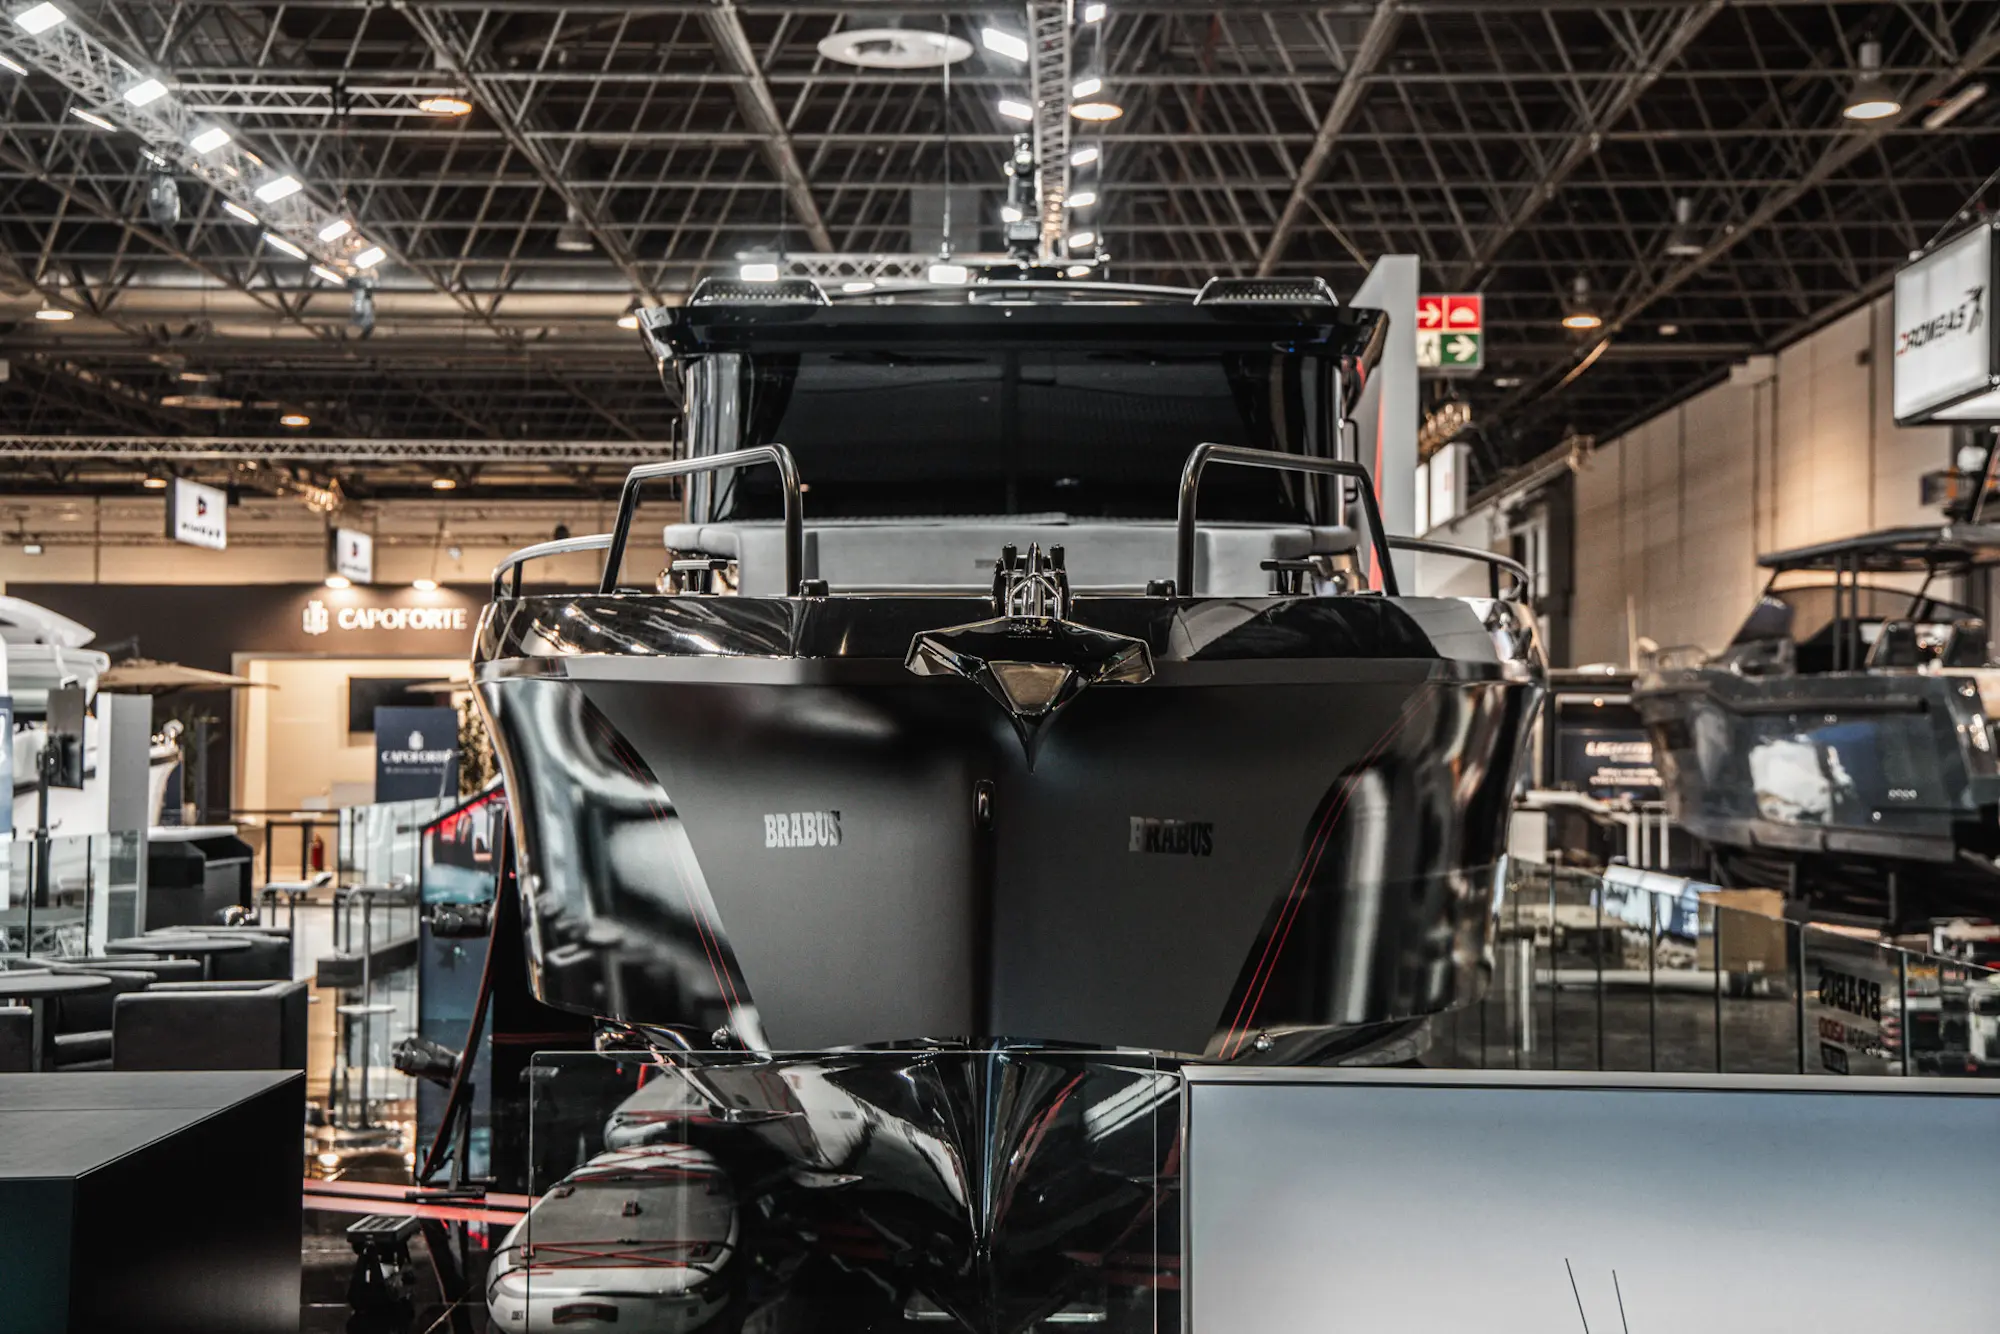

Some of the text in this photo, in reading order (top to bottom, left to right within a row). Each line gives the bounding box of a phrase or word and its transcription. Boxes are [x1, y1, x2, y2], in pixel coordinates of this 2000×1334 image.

[337, 607, 467, 630] CAPOFORTE
[763, 810, 842, 848] BRABUS
[1128, 816, 1214, 857] BRABUS
